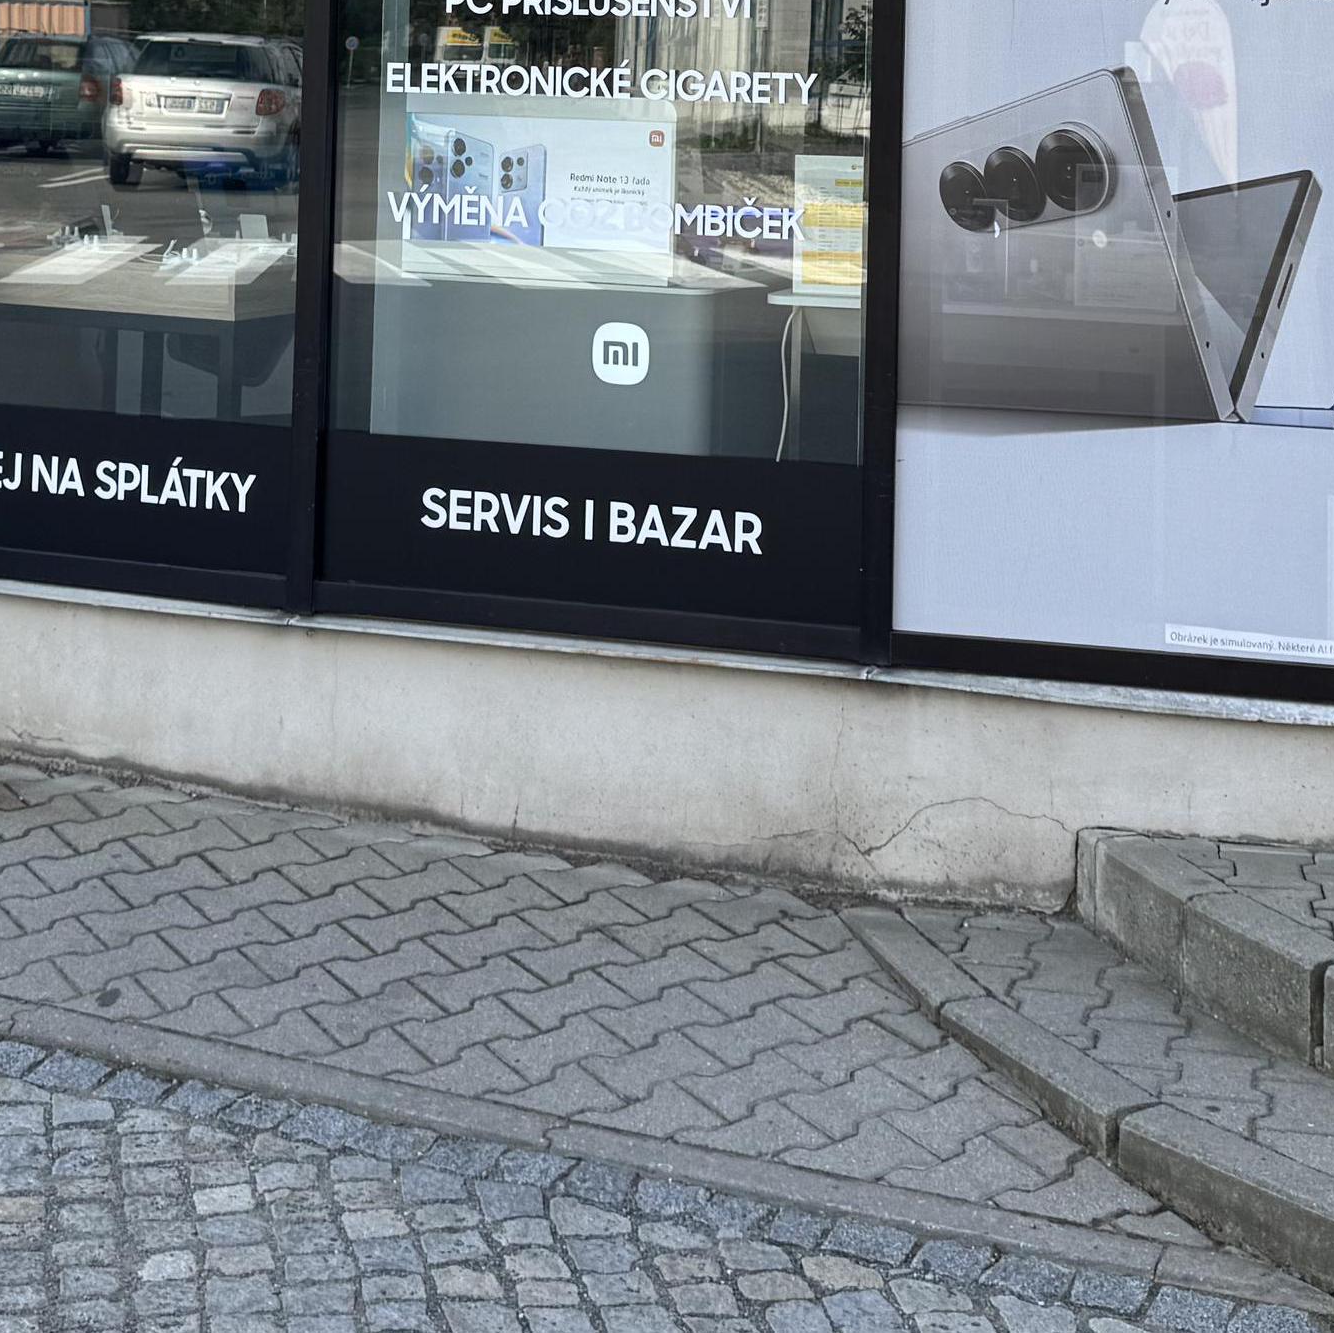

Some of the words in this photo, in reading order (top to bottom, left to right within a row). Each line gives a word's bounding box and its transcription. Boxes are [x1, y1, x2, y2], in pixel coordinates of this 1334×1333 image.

[386, 60, 631, 101] ELEKTRONICKÉ
[639, 68, 819, 105] CIGARETY
[570, 172, 594, 183] Redmi
[596, 174, 617, 185] Note
[620, 175, 629, 185] 13
[632, 175, 651, 186] řada
[387, 184, 528, 228] VÝMĚNA
[30, 453, 85, 496] NA
[94, 456, 257, 514] SPLÁTKY
[420, 487, 569, 540] SERVIS
[609, 502, 763, 556] BAZAR
[1170, 631, 1208, 645] Obrázek
[1209, 636, 1219, 646] je
